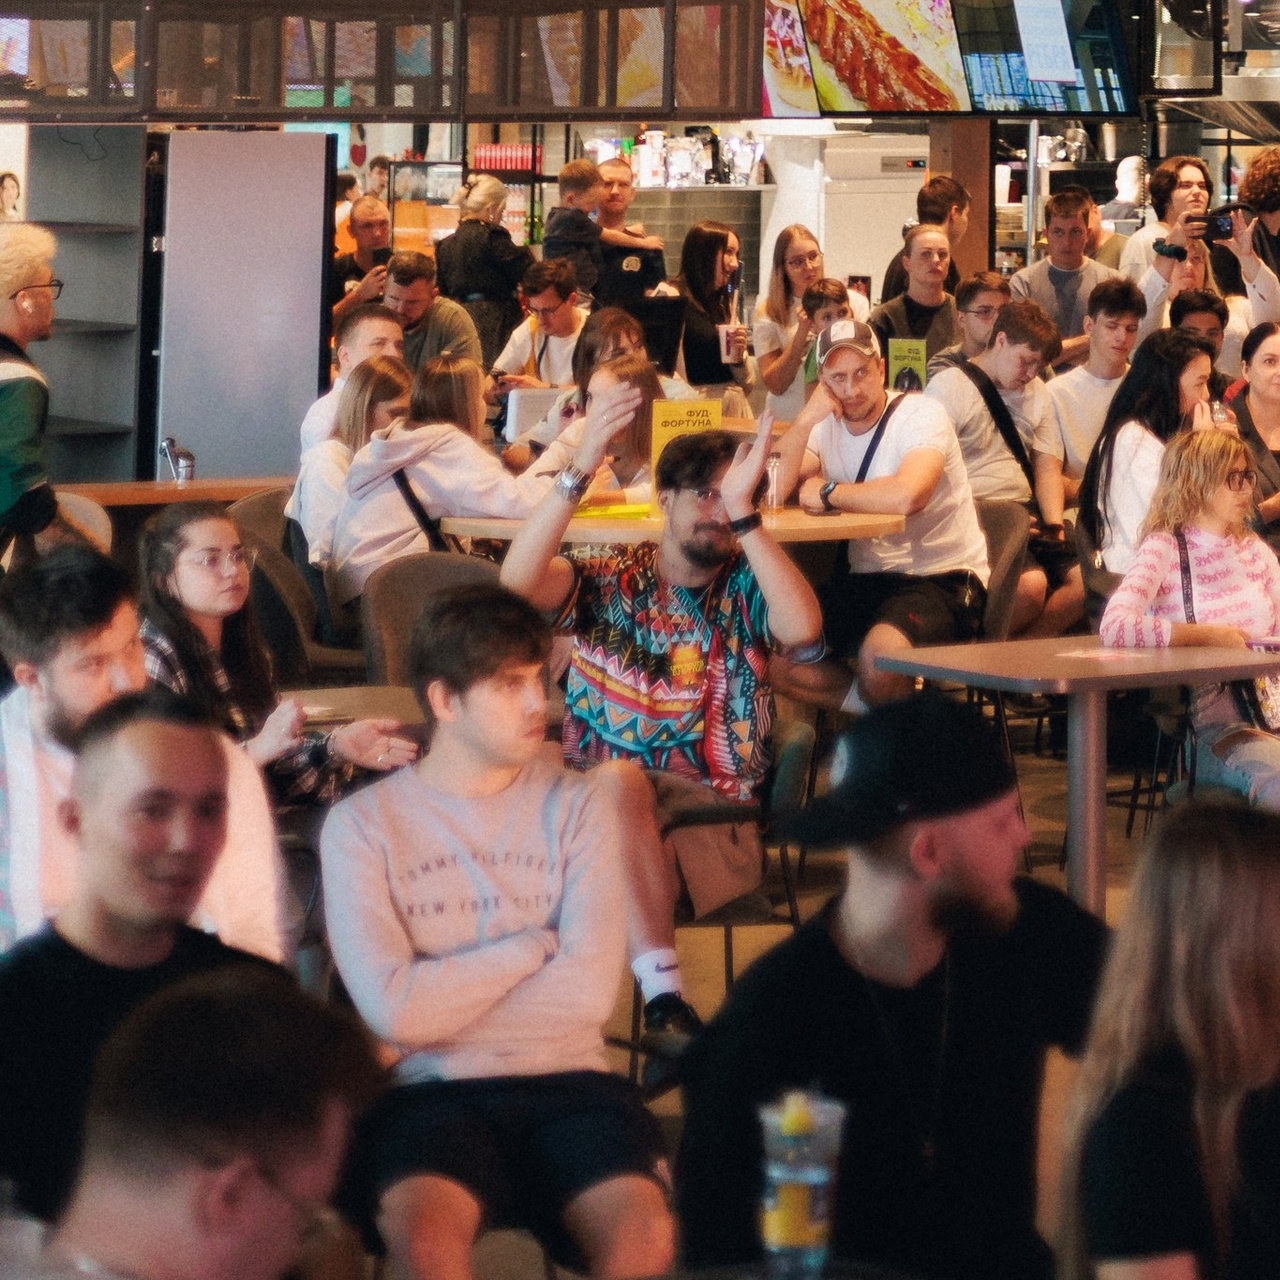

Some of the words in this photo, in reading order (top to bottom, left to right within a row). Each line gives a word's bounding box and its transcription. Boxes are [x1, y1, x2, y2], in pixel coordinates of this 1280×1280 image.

[661, 419, 712, 428] ФОРТУНА
[398, 852, 458, 882] OMMY
[406, 900, 445, 917] NEW
[460, 895, 501, 915] YORK
